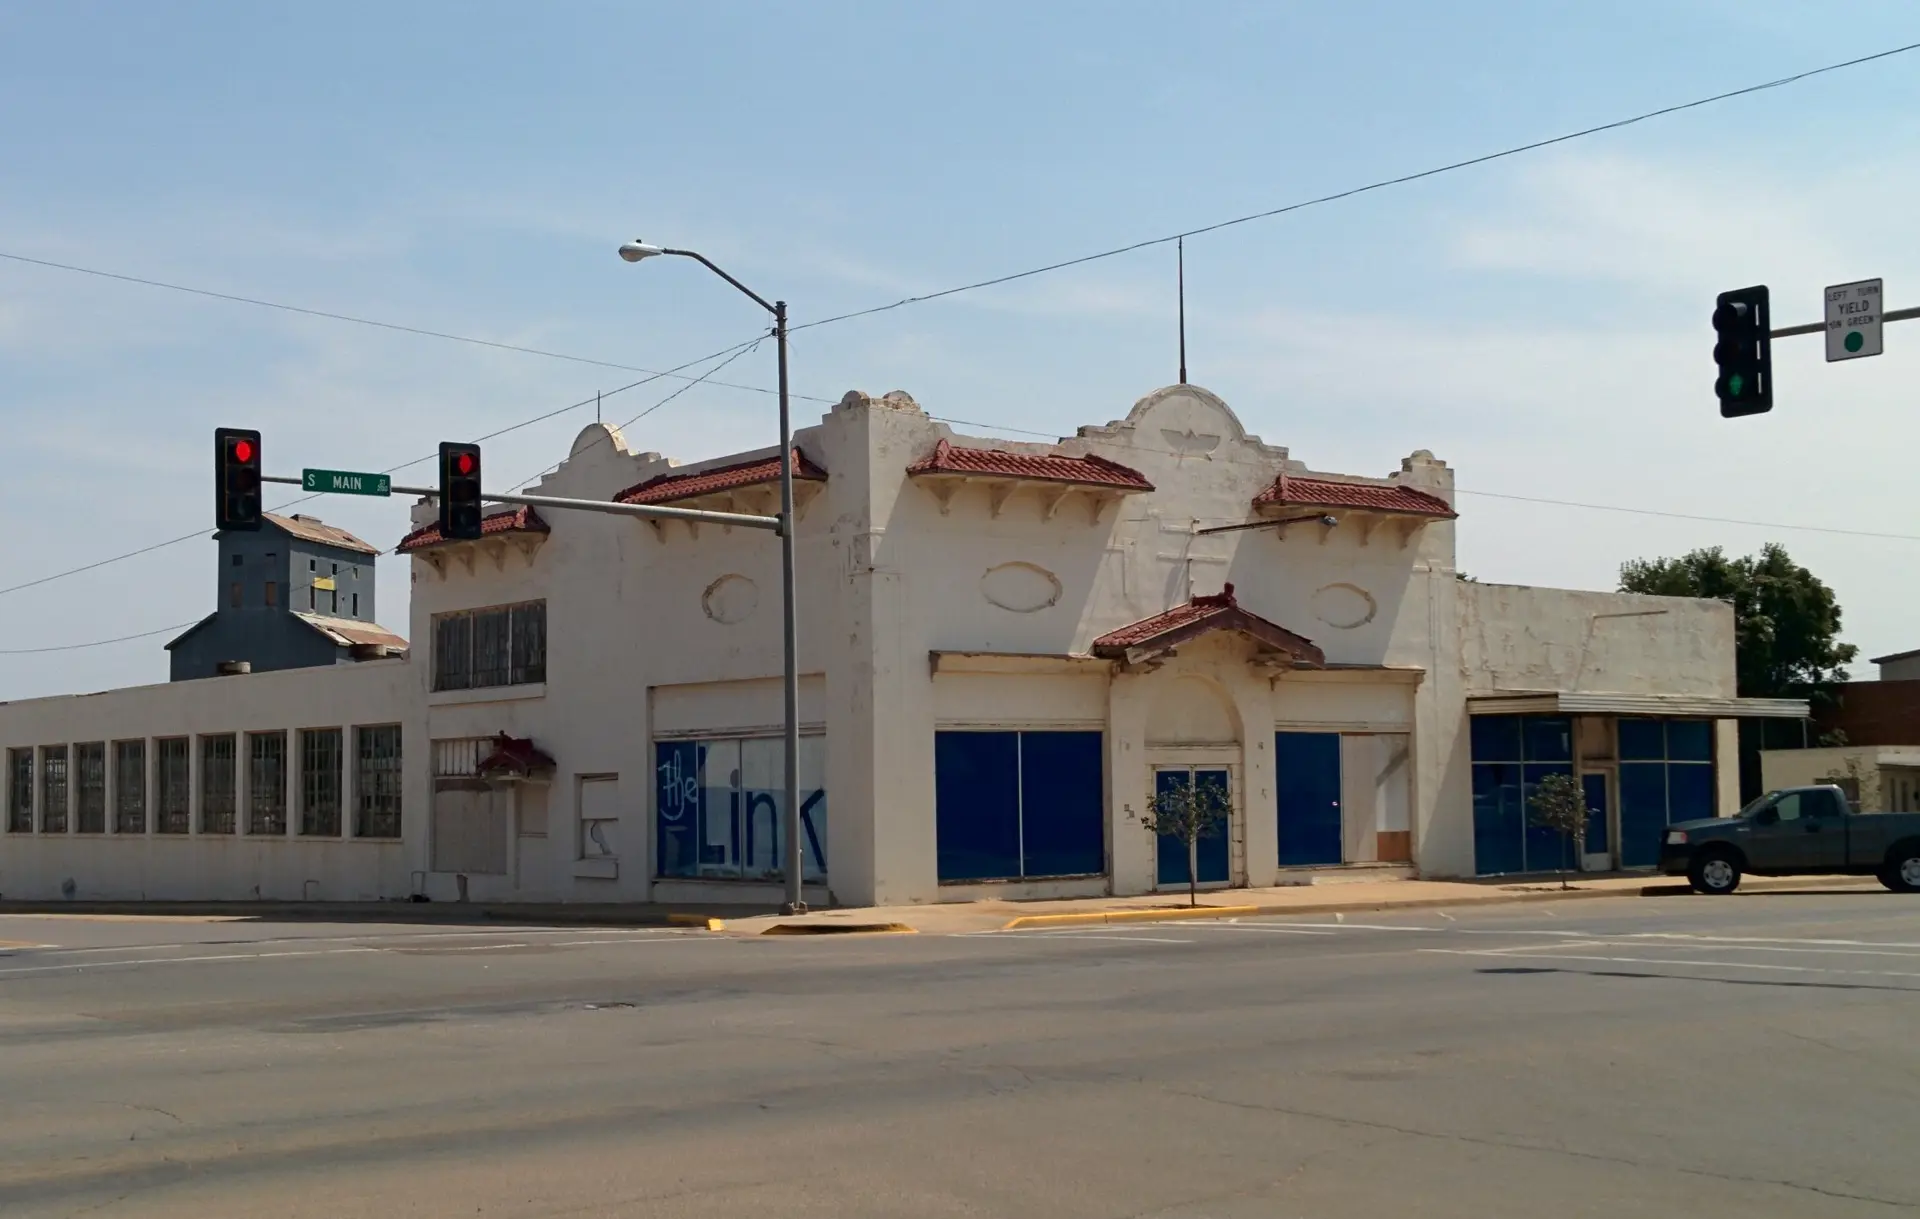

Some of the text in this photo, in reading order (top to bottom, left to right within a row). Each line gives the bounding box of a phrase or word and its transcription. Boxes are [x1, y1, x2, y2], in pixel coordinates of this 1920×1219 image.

[1828, 290, 1847, 302] LEFT
[1838, 300, 1870, 315] YIELD
[1847, 315, 1874, 327] GREEN
[307, 473, 362, 490] S MAIN
